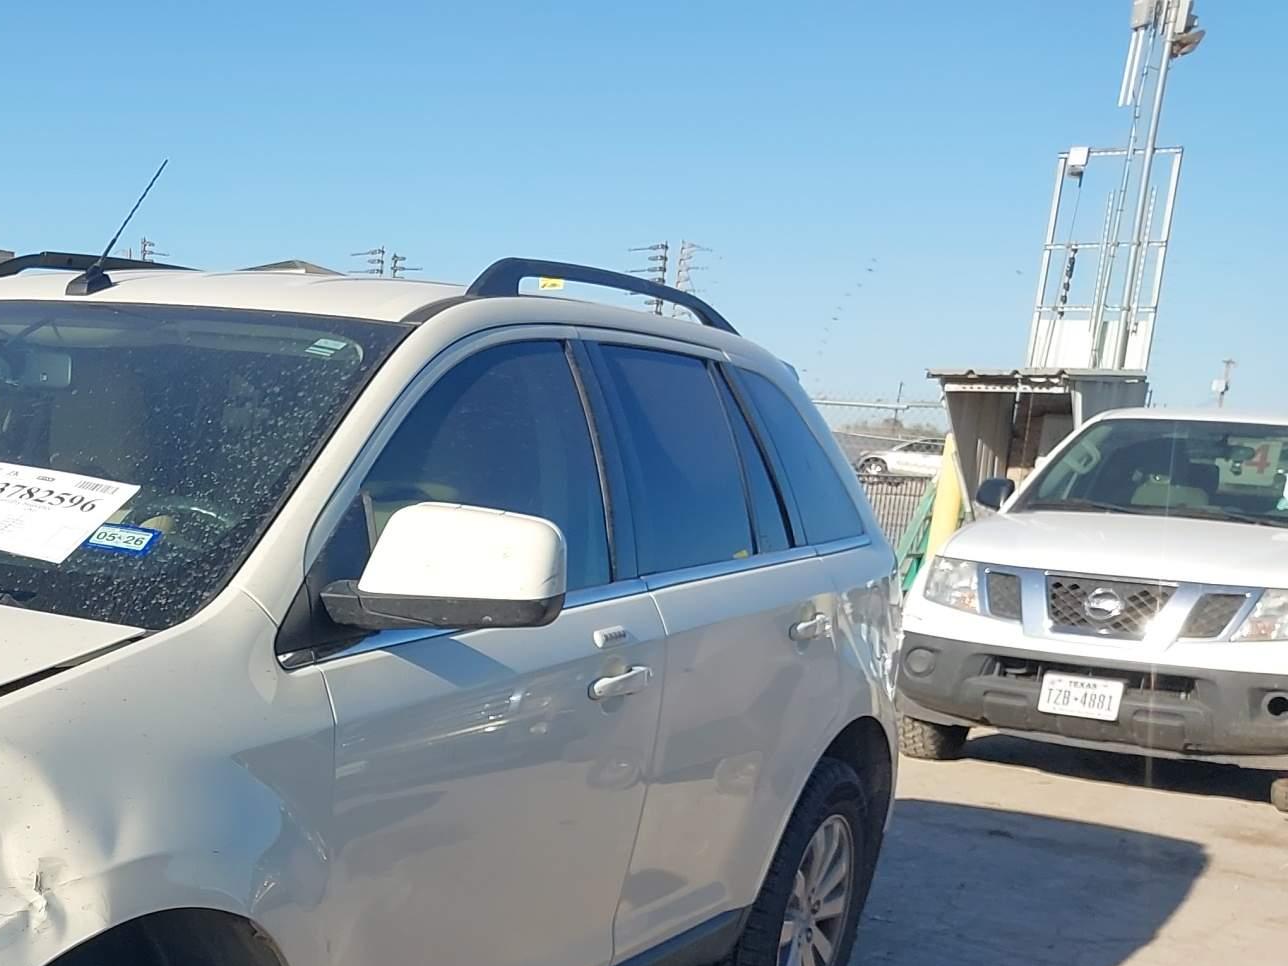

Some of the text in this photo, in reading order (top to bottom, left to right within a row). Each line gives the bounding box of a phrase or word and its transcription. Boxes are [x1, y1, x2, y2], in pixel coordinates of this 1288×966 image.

[96, 531, 145, 546] 05 26
[1068, 680, 1098, 690] TEXAS
